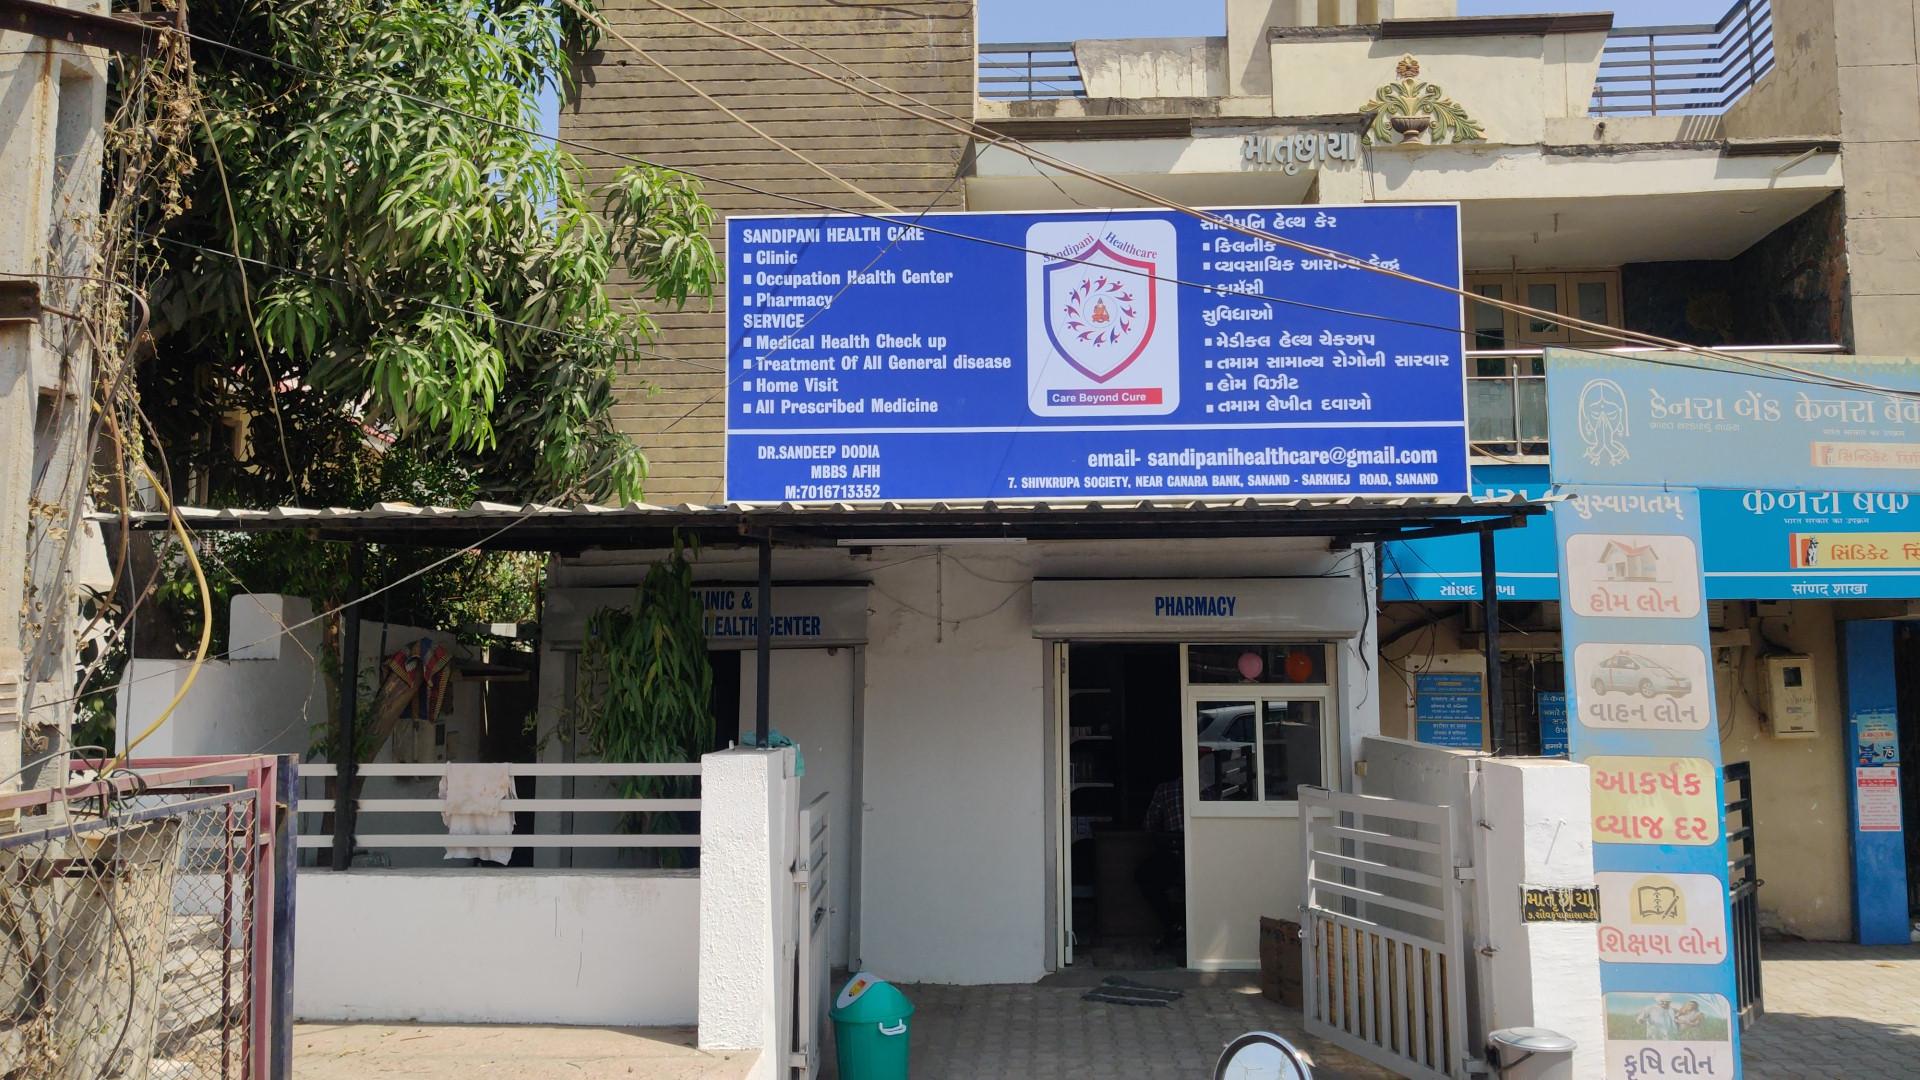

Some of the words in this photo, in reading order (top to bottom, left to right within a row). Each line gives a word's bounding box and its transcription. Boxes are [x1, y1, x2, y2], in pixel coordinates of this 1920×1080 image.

[1244, 133, 1356, 176] માતૃછાયા
[1313, 212, 1336, 228] કેર
[743, 229, 820, 244] SANDIPANI
[827, 227, 880, 242] HEALTH
[887, 227, 925, 241] CARE
[1043, 232, 1095, 263] Sandipani
[1105, 231, 1157, 259] Healthcare
[756, 250, 798, 265] Clinic
[756, 271, 841, 287] Occupation
[847, 270, 896, 285] Health
[902, 269, 953, 284] Center
[756, 293, 833, 310] Pharmacy
[743, 313, 804, 329] SERVICE
[1202, 303, 1273, 326] સુવિધાઓ
[756, 335, 814, 350] Medical
[821, 334, 870, 349] Health
[876, 334, 921, 348] Check
[928, 336, 947, 350] up
[1216, 332, 1271, 348] મેડીકલ
[1279, 331, 1312, 347] હેલ્થ
[1319, 330, 1375, 347] ચેકઅપ
[756, 356, 835, 371] Treatment
[841, 355, 859, 370] Of
[863, 355, 882, 369] All
[888, 355, 946, 370] General
[953, 354, 1011, 369] disease
[1217, 357, 1259, 369] તમામ
[1266, 355, 1324, 368] સામાન્ય
[1332, 350, 1385, 368] રોગોની
[1395, 354, 1449, 367] સારવાર
[756, 378, 798, 393] Home
[804, 377, 839, 392] Visit
[1217, 373, 1247, 391] હોમ
[1253, 373, 1299, 390] વિઝીટ
[755, 399, 775, 414] All
[781, 399, 864, 414] Prescribed
[871, 398, 939, 413] Medicine
[1052, 393, 1076, 403] Care
[1079, 393, 1118, 404] Beyond
[1121, 392, 1146, 402] Cure
[1218, 401, 1260, 413] તમામ
[1266, 395, 1313, 411] લેખીત
[1321, 393, 1372, 411] દવાઓ
[1795, 392, 1875, 423] केनरा
[758, 445, 836, 460] DR.SANDEEP
[841, 445, 880, 459] DODIA
[1088, 448, 1141, 468] email-
[1148, 446, 1438, 470] sandipanihealthcare@gmail.com
[811, 465, 847, 479] MBBS
[852, 464, 881, 478] AFIH
[1021, 476, 1080, 488] SHIVKRUPA
[1084, 476, 1131, 489] SOCIETY,
[1135, 475, 1163, 488] NEAR
[1167, 475, 1208, 487] CANARA
[1212, 474, 1244, 488] BANK,
[1248, 474, 1289, 486] SANAND
[1302, 473, 1350, 486] SARKHEJ
[1360, 473, 1391, 486] ROAD,
[1395, 473, 1438, 485] SANAND
[785, 484, 881, 499] M:7016713352
[692, 591, 735, 610] INIC
[741, 591, 753, 609] &
[1155, 596, 1236, 617] PHARMACY
[1590, 586, 1630, 613] હોમ
[1636, 587, 1680, 613] લોન
[1589, 702, 1647, 722] વાહન
[1653, 697, 1698, 723] લોન
[1595, 763, 1702, 796] આકર્ષક
[1595, 814, 1664, 839] વ્યાજ
[1675, 816, 1709, 841] દર
[1600, 926, 1670, 956] શિક્ષણ
[1678, 928, 1722, 956] લોન
[1671, 1047, 1715, 1075] લોન
